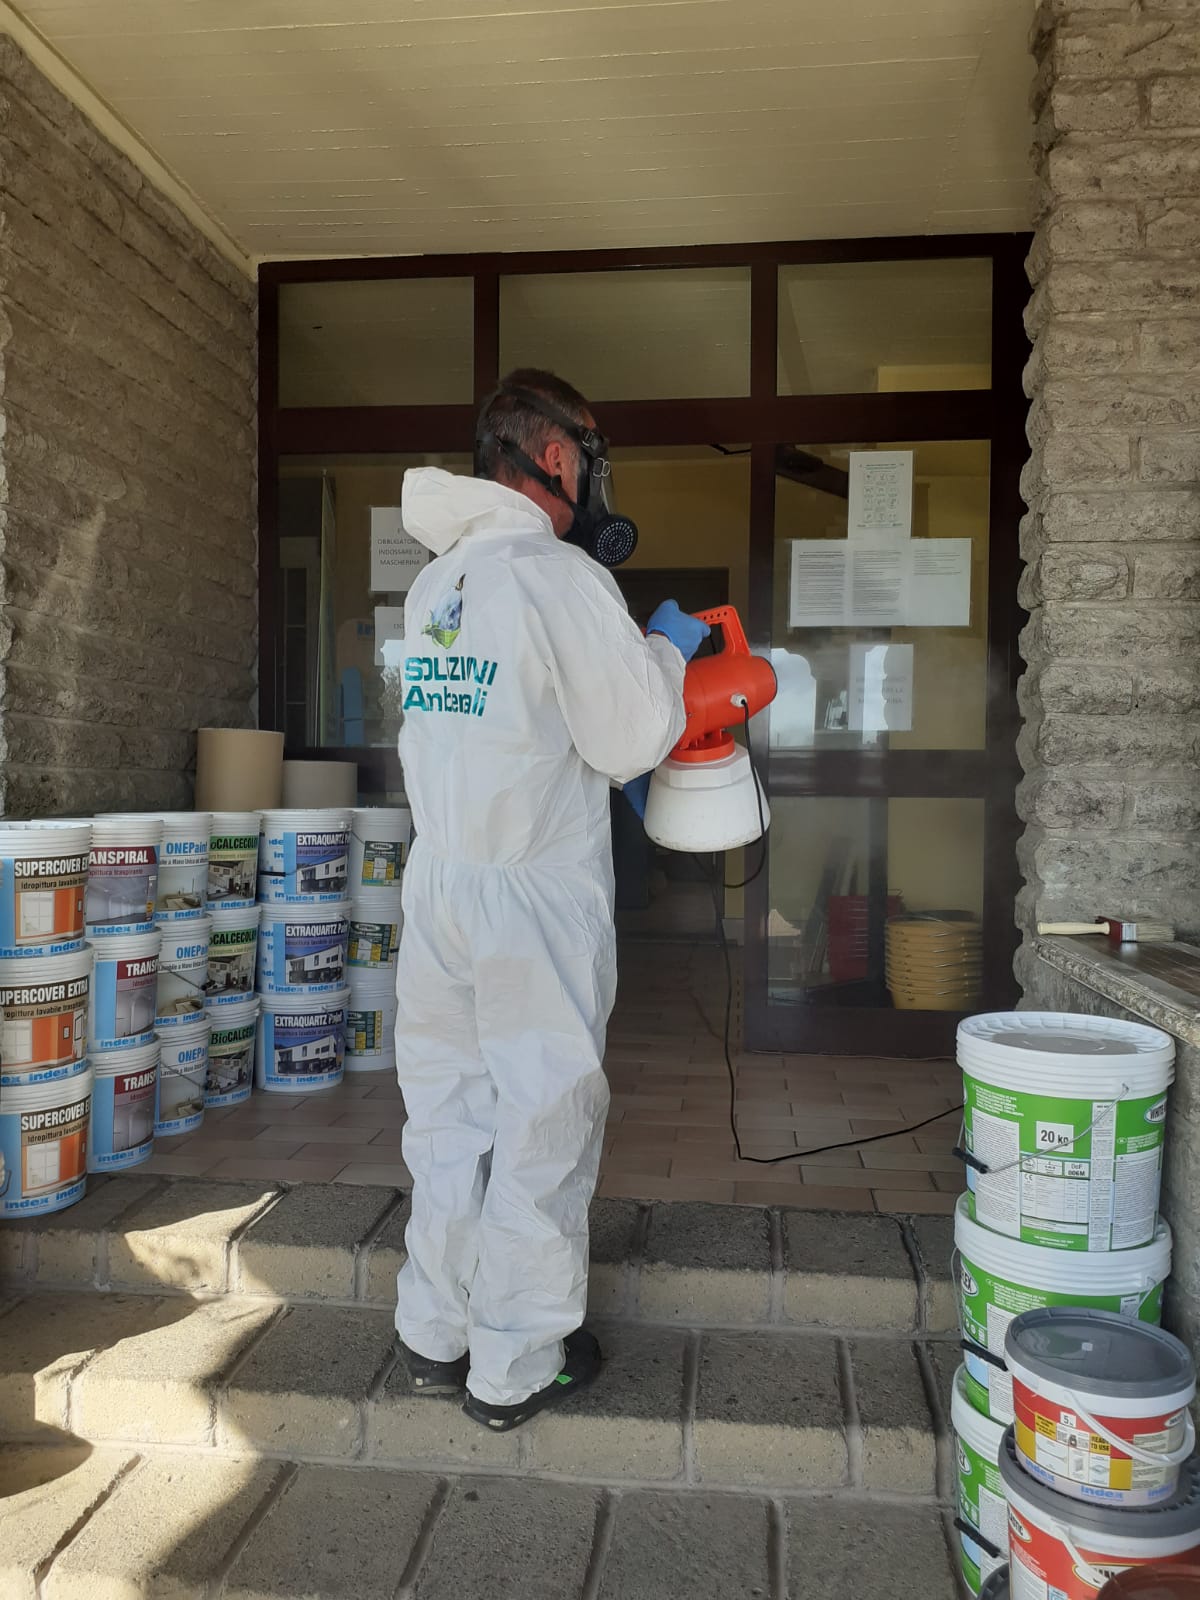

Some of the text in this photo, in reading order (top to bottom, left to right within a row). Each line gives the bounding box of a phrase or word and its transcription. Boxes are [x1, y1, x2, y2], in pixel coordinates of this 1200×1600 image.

[88, 850, 148, 865] ANSPIRAL
[14, 857, 80, 877] SUPERCOVER
[285, 924, 337, 937] EXTRAQUARTZ
[0, 985, 65, 1005] UPERCOVER
[274, 1014, 328, 1028] EXTRAQUARTZ
[28, 1067, 69, 1081] index
[21, 1102, 84, 1131] SUPERCOVER
[1040, 1130, 1069, 1147] 20 kg
[5, 1197, 49, 1208] index
[1063, 1415, 1069, 1425] 5
[1080, 1485, 1124, 1499] index
